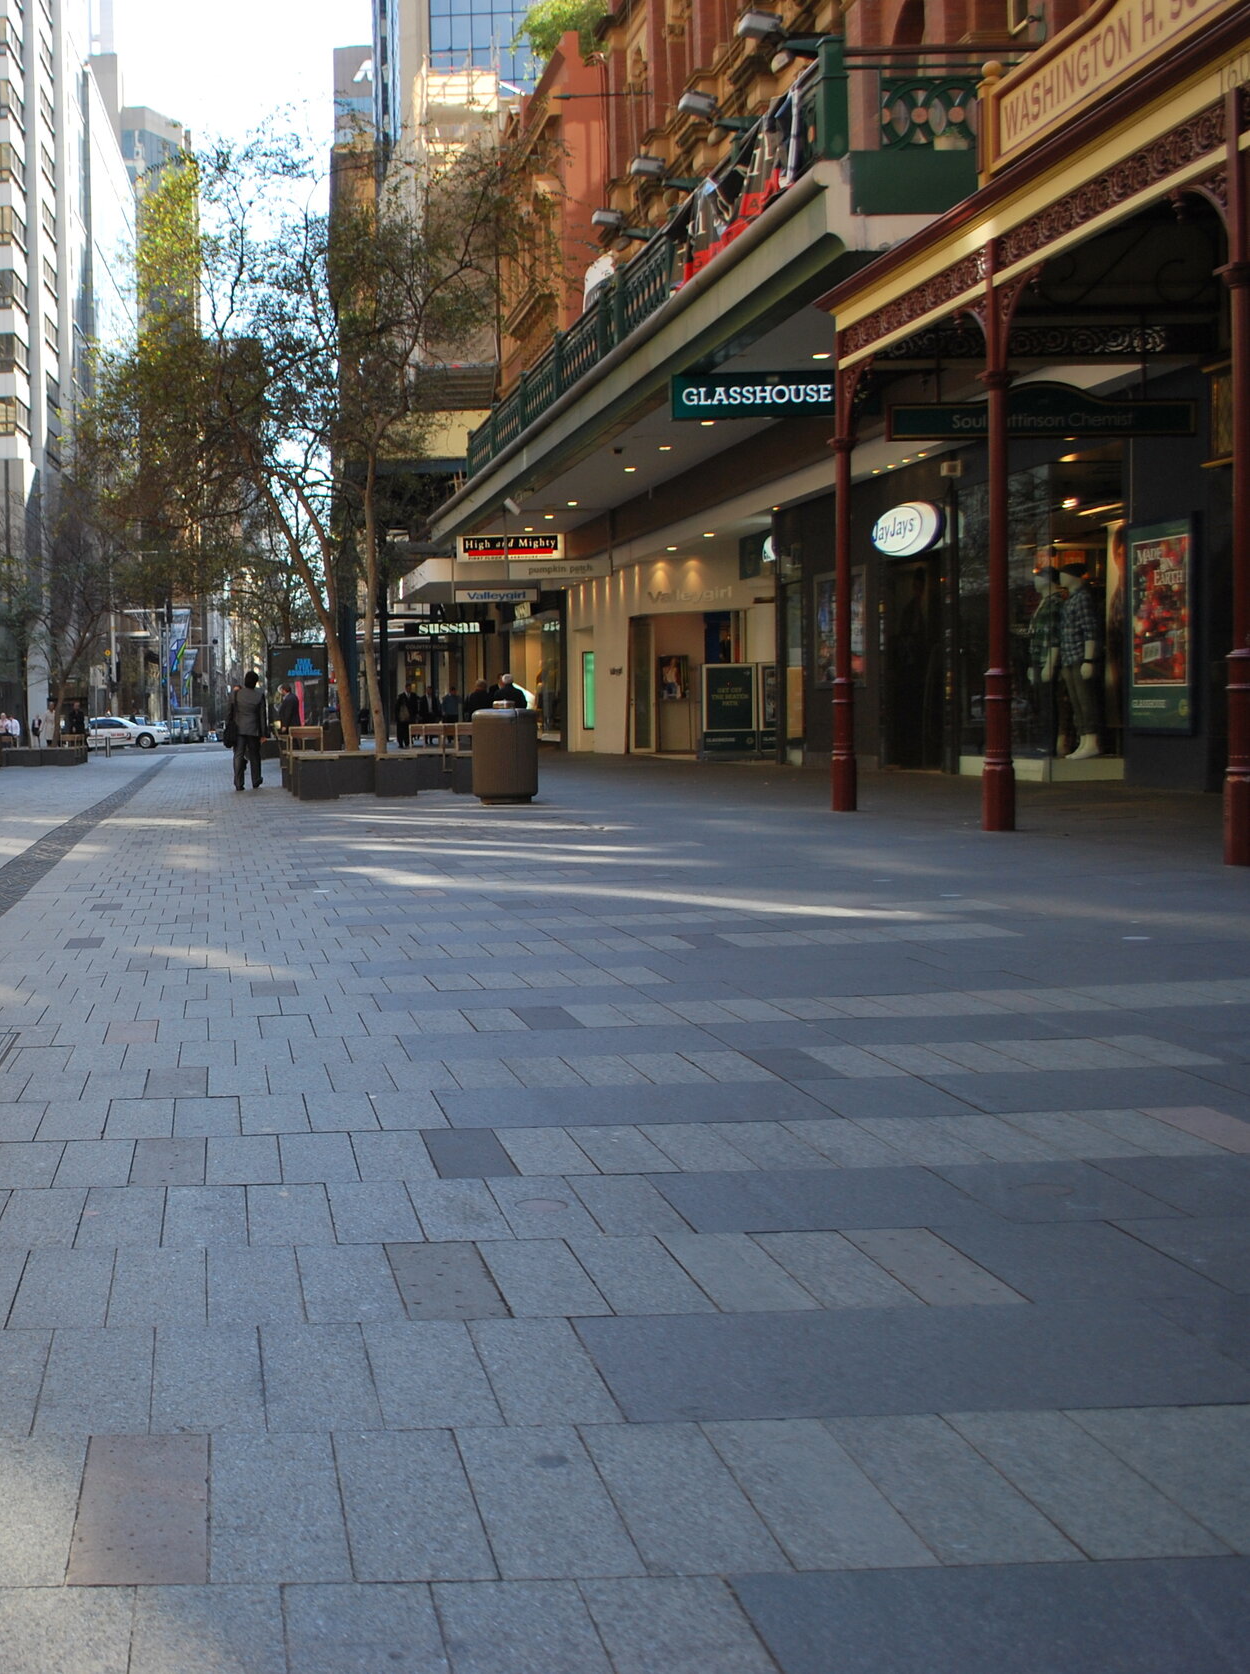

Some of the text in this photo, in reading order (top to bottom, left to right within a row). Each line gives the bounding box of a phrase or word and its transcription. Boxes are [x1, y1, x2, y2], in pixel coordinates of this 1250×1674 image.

[1004, 11, 1133, 140] WASHINGTON
[1142, 0, 1163, 42] H.
[682, 384, 833, 406] GLASSHOUSE
[952, 415, 987, 428] Soul
[1069, 411, 1134, 427] Chemist
[871, 517, 915, 544] JayJays
[465, 538, 491, 550] High
[518, 537, 556, 549] Mighty
[528, 564, 593, 575] pumpkin patch
[1153, 570, 1183, 586] EARTH
[467, 592, 526, 601] Valleygirl
[419, 622, 480, 634] sussan
